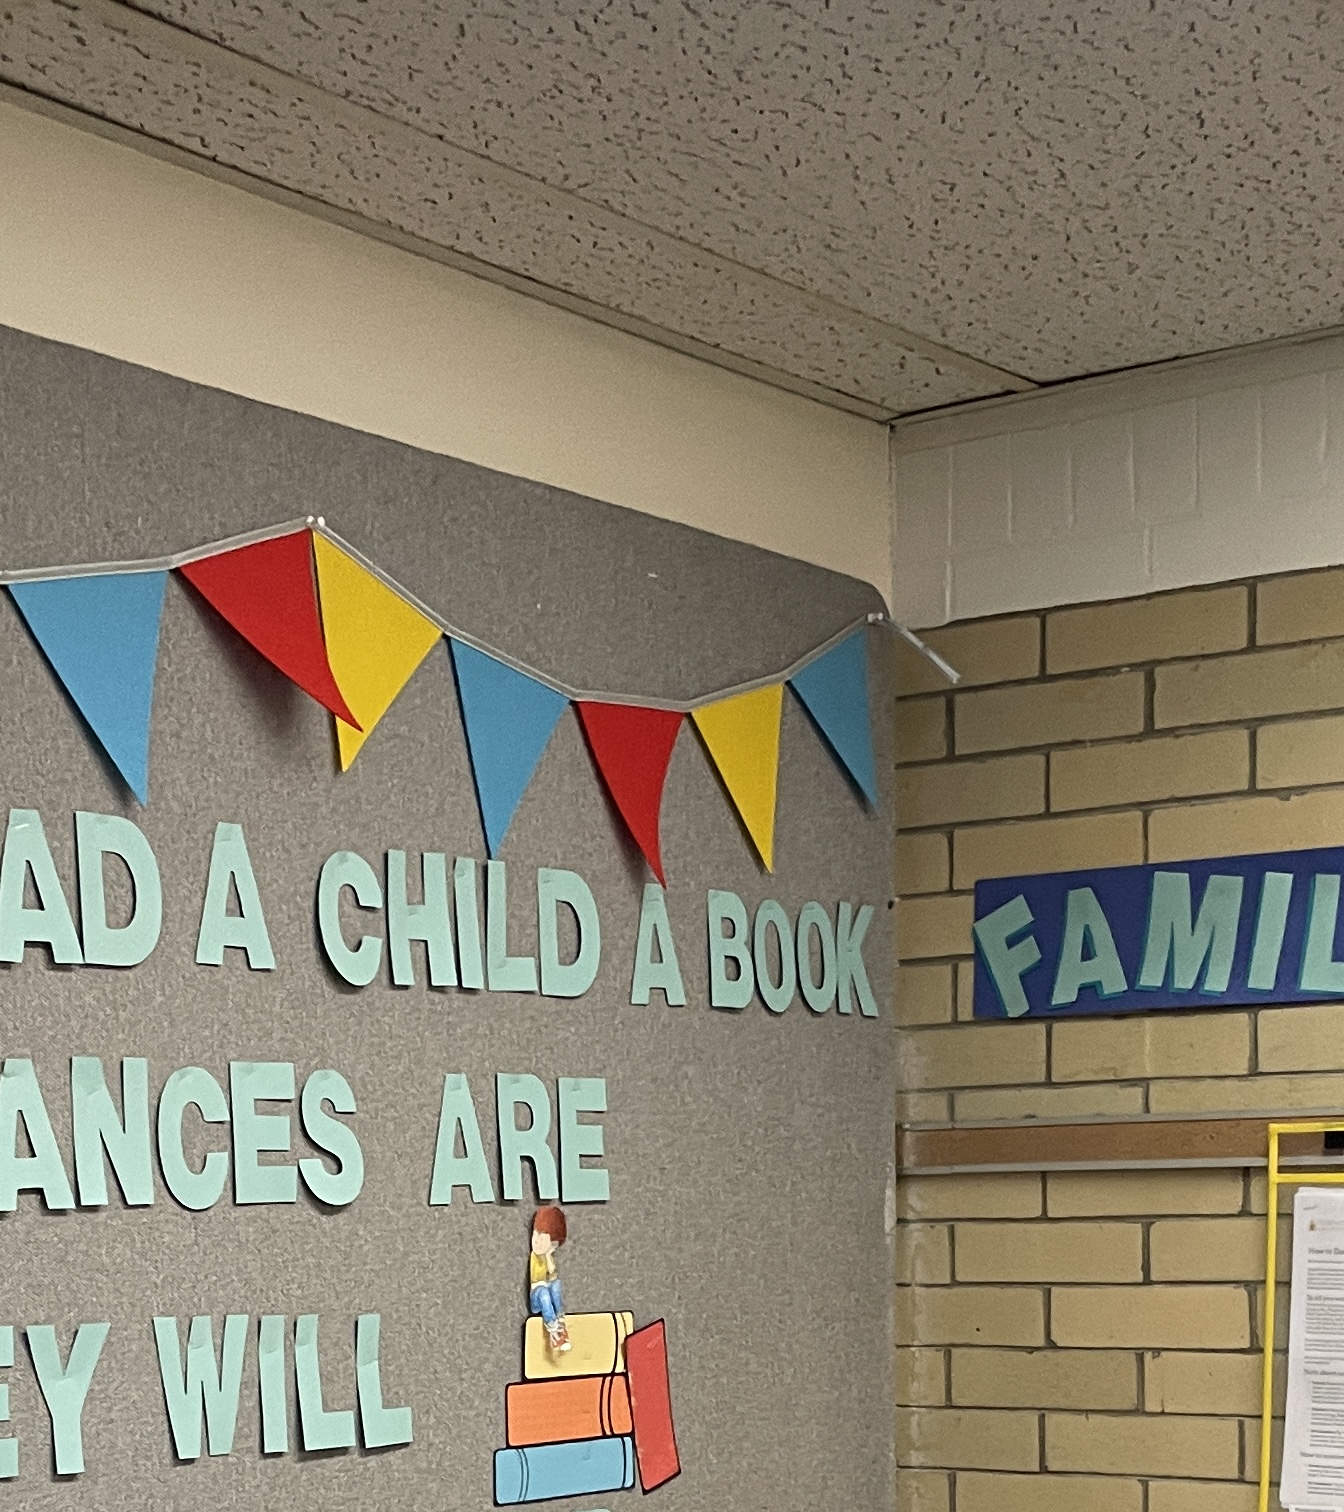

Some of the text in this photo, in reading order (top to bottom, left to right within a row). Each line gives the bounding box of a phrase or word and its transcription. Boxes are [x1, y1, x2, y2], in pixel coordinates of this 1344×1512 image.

[195, 822, 276, 970] A
[317, 848, 601, 999] CHILD
[631, 883, 686, 1006] A
[708, 889, 879, 1018] BOOK
[429, 1073, 610, 1206] ARE
[152, 1313, 413, 1461] WILL
